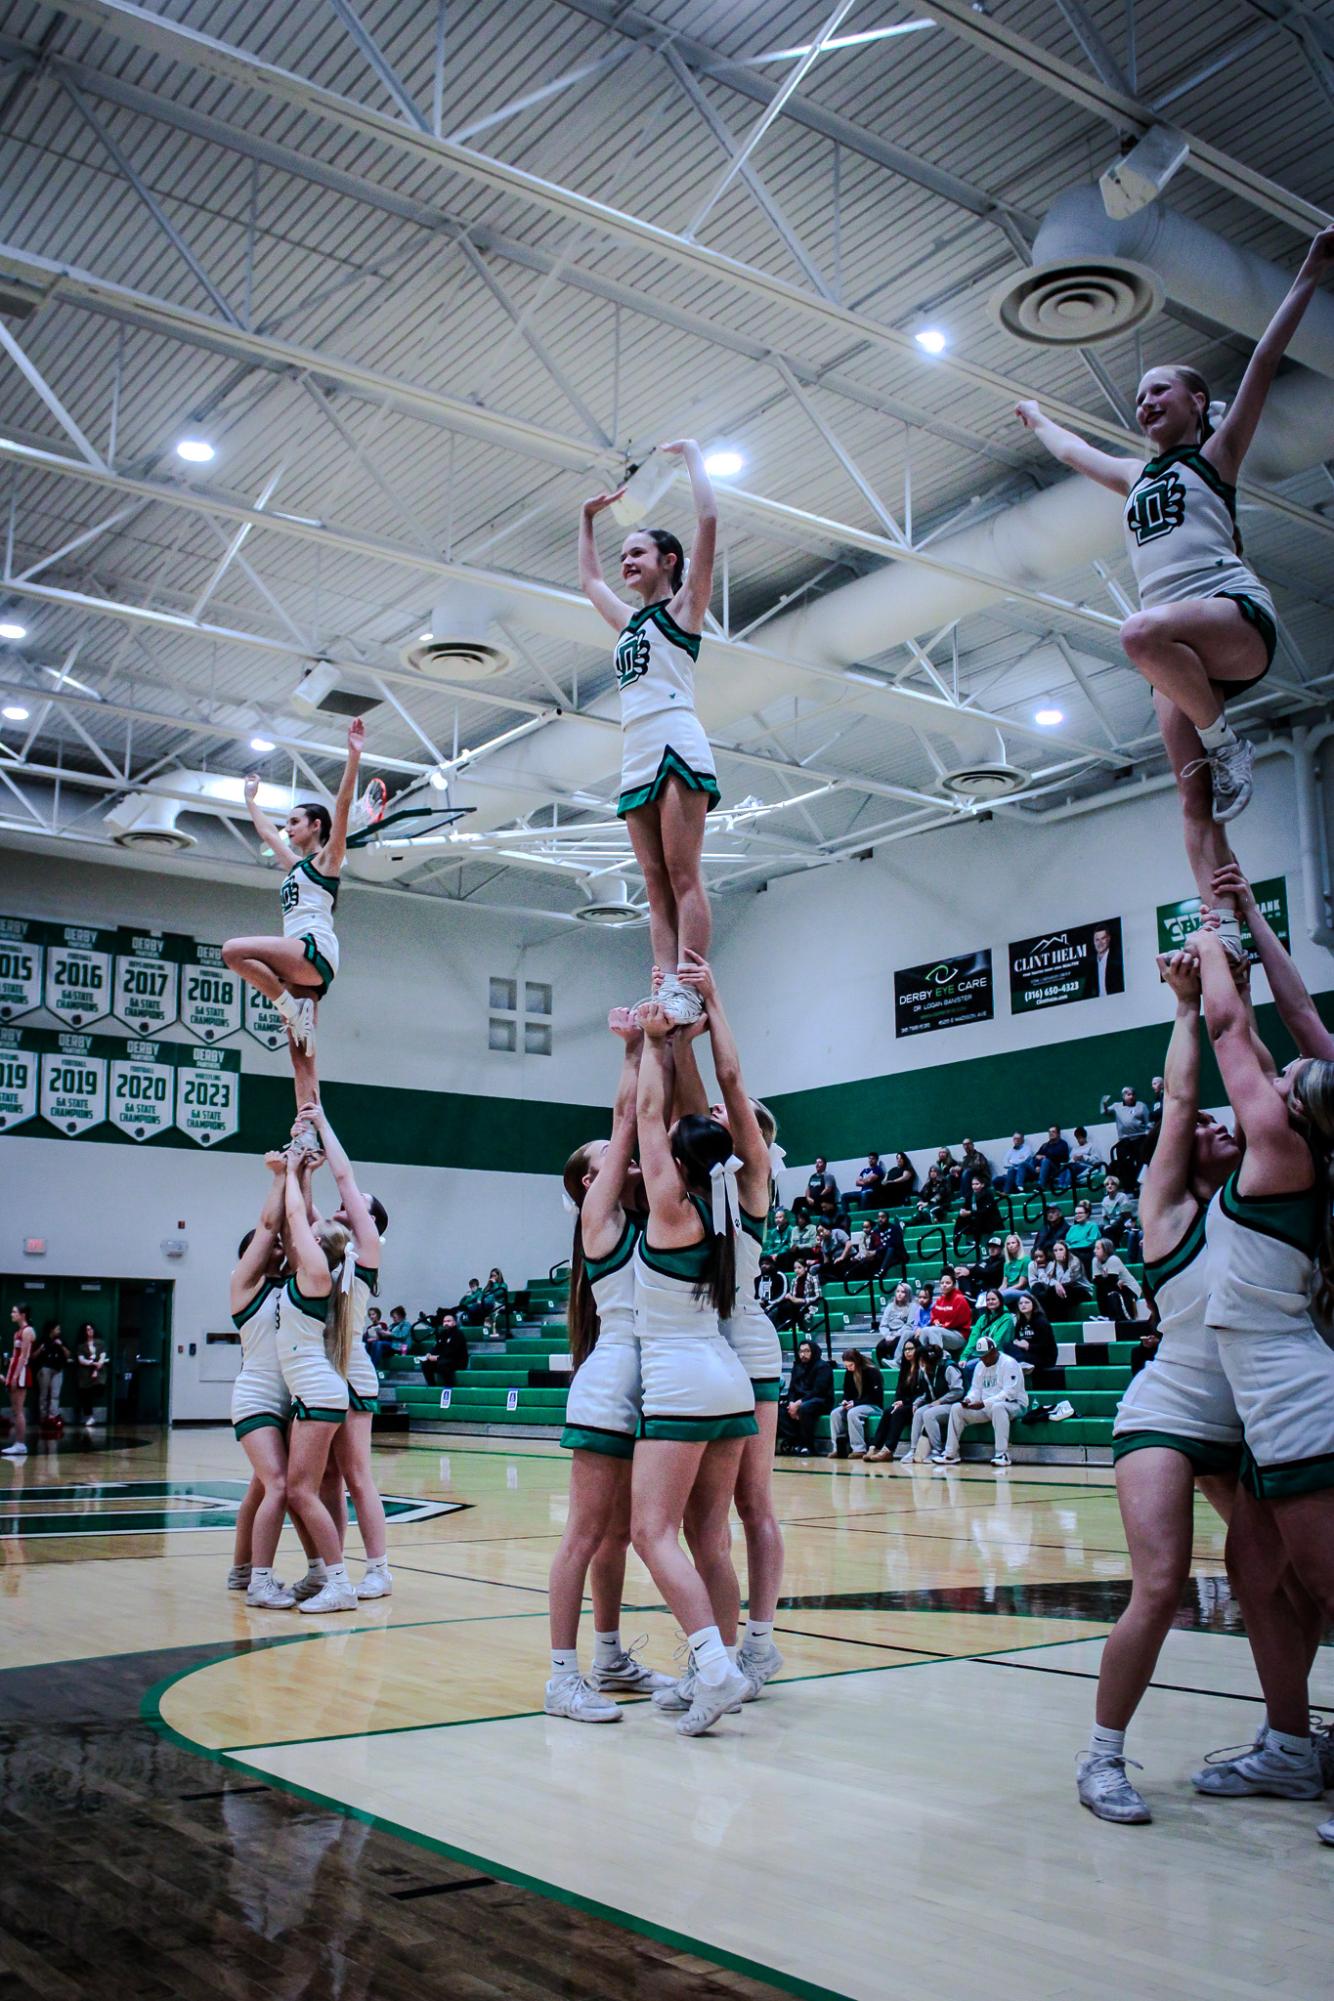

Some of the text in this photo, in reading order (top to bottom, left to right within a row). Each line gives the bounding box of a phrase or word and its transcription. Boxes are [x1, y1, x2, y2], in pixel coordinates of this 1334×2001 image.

[64, 927, 98, 943] DERBY
[132, 936, 165, 953] DERBY
[196, 945, 222, 959] DERB
[1013, 952, 1051, 973] CLINT
[1051, 943, 1087, 965] HELM
[0, 954, 32, 981] 015
[54, 960, 103, 989] 2016
[123, 969, 168, 996] 2017
[73, 991, 94, 1002] STATE
[188, 978, 234, 1005] 2018
[899, 977, 988, 1006] DERBY EYE CARE
[1024, 980, 1080, 1003] (316) 650-4323
[141, 999, 160, 1010] STATE
[206, 1007, 225, 1017] STATE
[58, 1033, 93, 1049] DERBY
[127, 1040, 160, 1056] DERBY
[193, 1048, 225, 1063] DERBY
[49, 1067, 98, 1095] 2019
[116, 1074, 166, 1101] 2020
[183, 1081, 230, 1108] 2023
[68, 1098, 89, 1109] STATE
[125, 1103, 157, 1114] 6A STATE
[50, 1107, 94, 1119] CHAMPIONS
[119, 1113, 161, 1125] CHAMPIONS
[191, 1109, 222, 1121] 6A STATE
[186, 1119, 226, 1131] CHAMPIONS
